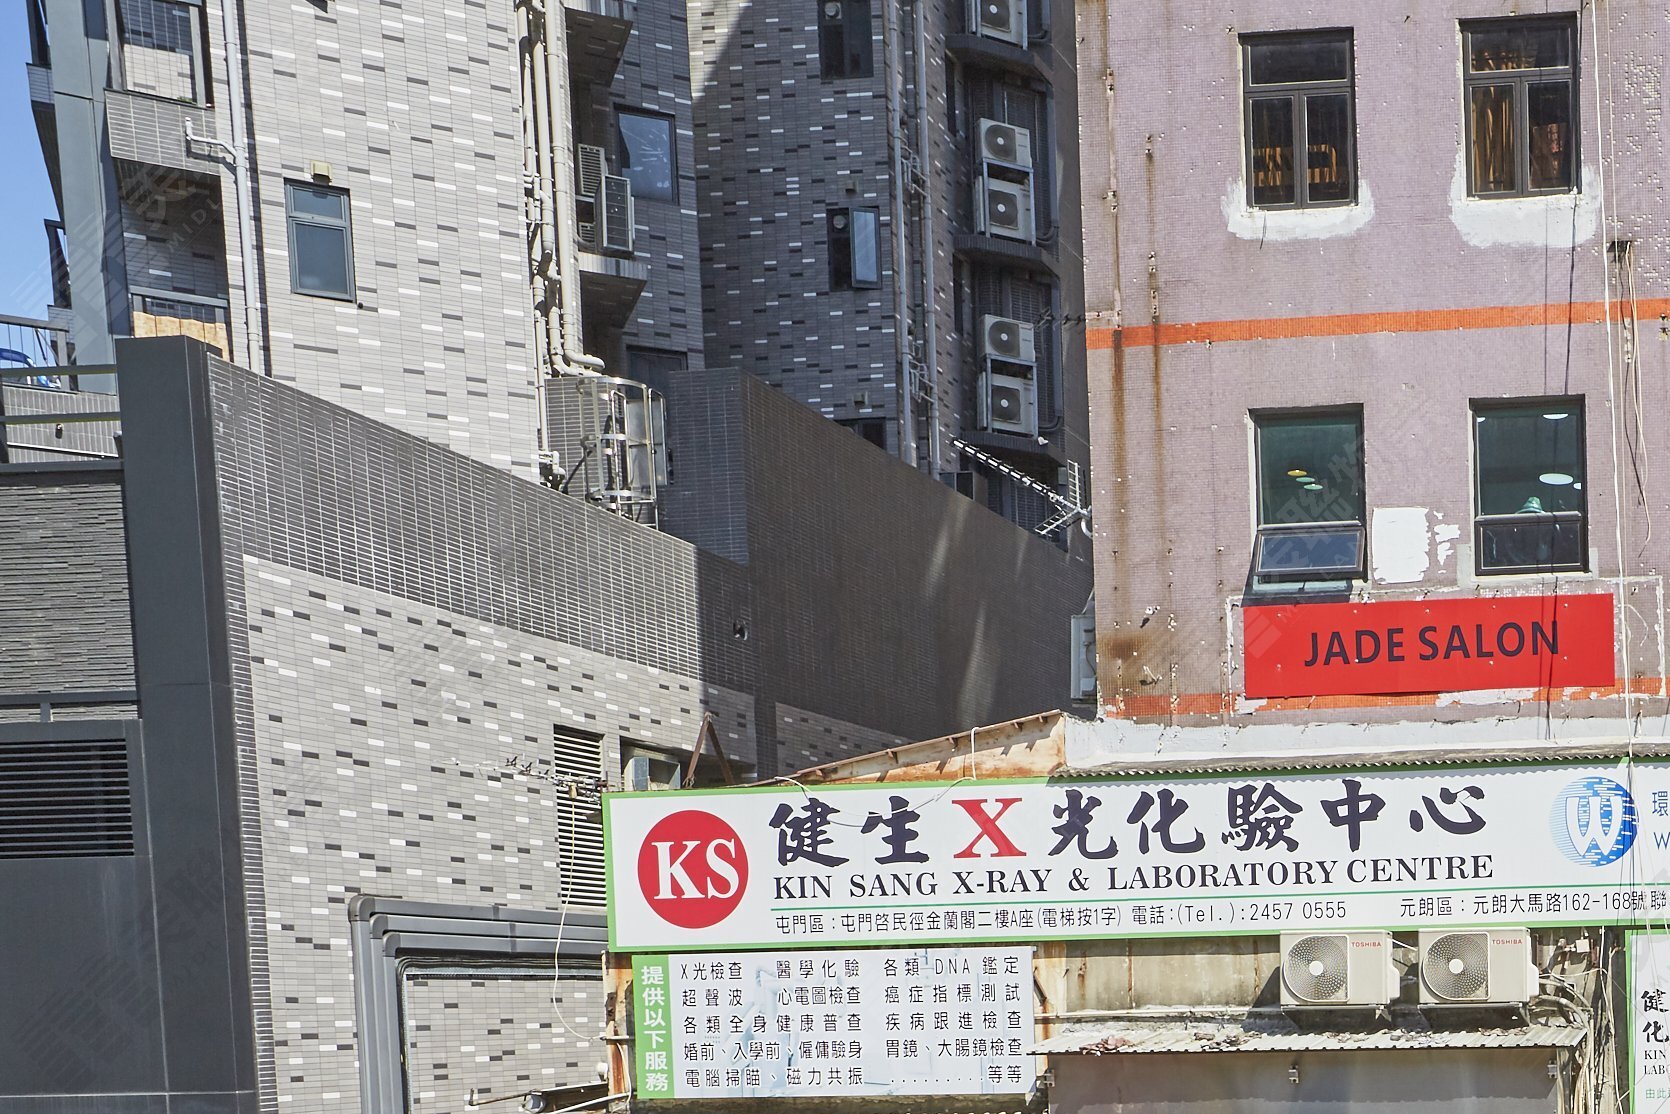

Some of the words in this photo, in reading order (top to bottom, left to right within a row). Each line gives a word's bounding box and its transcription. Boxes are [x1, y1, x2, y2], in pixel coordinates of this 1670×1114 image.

[1304, 628, 1405, 667] JADE
[1419, 620, 1559, 660] SALON
[767, 779, 1488, 867] 健生X光化驗中心
[649, 837, 741, 900] KS
[773, 875, 833, 901] KIN
[849, 872, 939, 900] SANG
[952, 869, 1053, 897] X-RAY
[1068, 868, 1092, 893] &
[1106, 860, 1340, 892] LABORATORY
[1346, 854, 1495, 885] CENTRE
[1303, 900, 1347, 921] 0555
[680, 960, 744, 981] X光檢查
[776, 959, 860, 980] 醫學化驗
[883, 957, 921, 978] 各類
[934, 957, 971, 976] DNA
[982, 956, 1021, 975] 鑑定
[682, 988, 744, 1008] 超聲波
[777, 986, 861, 1006] 心電圖檢查
[884, 983, 1021, 1005] 癌症指標測試
[641, 965, 669, 1092] 提供以下服務
[683, 1013, 862, 1035] 各類全身健康普查
[885, 1011, 1022, 1032] 疾病跟進檢查
[885, 1038, 1023, 1059] 胃鏡、大腸鏡檢查
[1644, 1049, 1667, 1060] KIN
